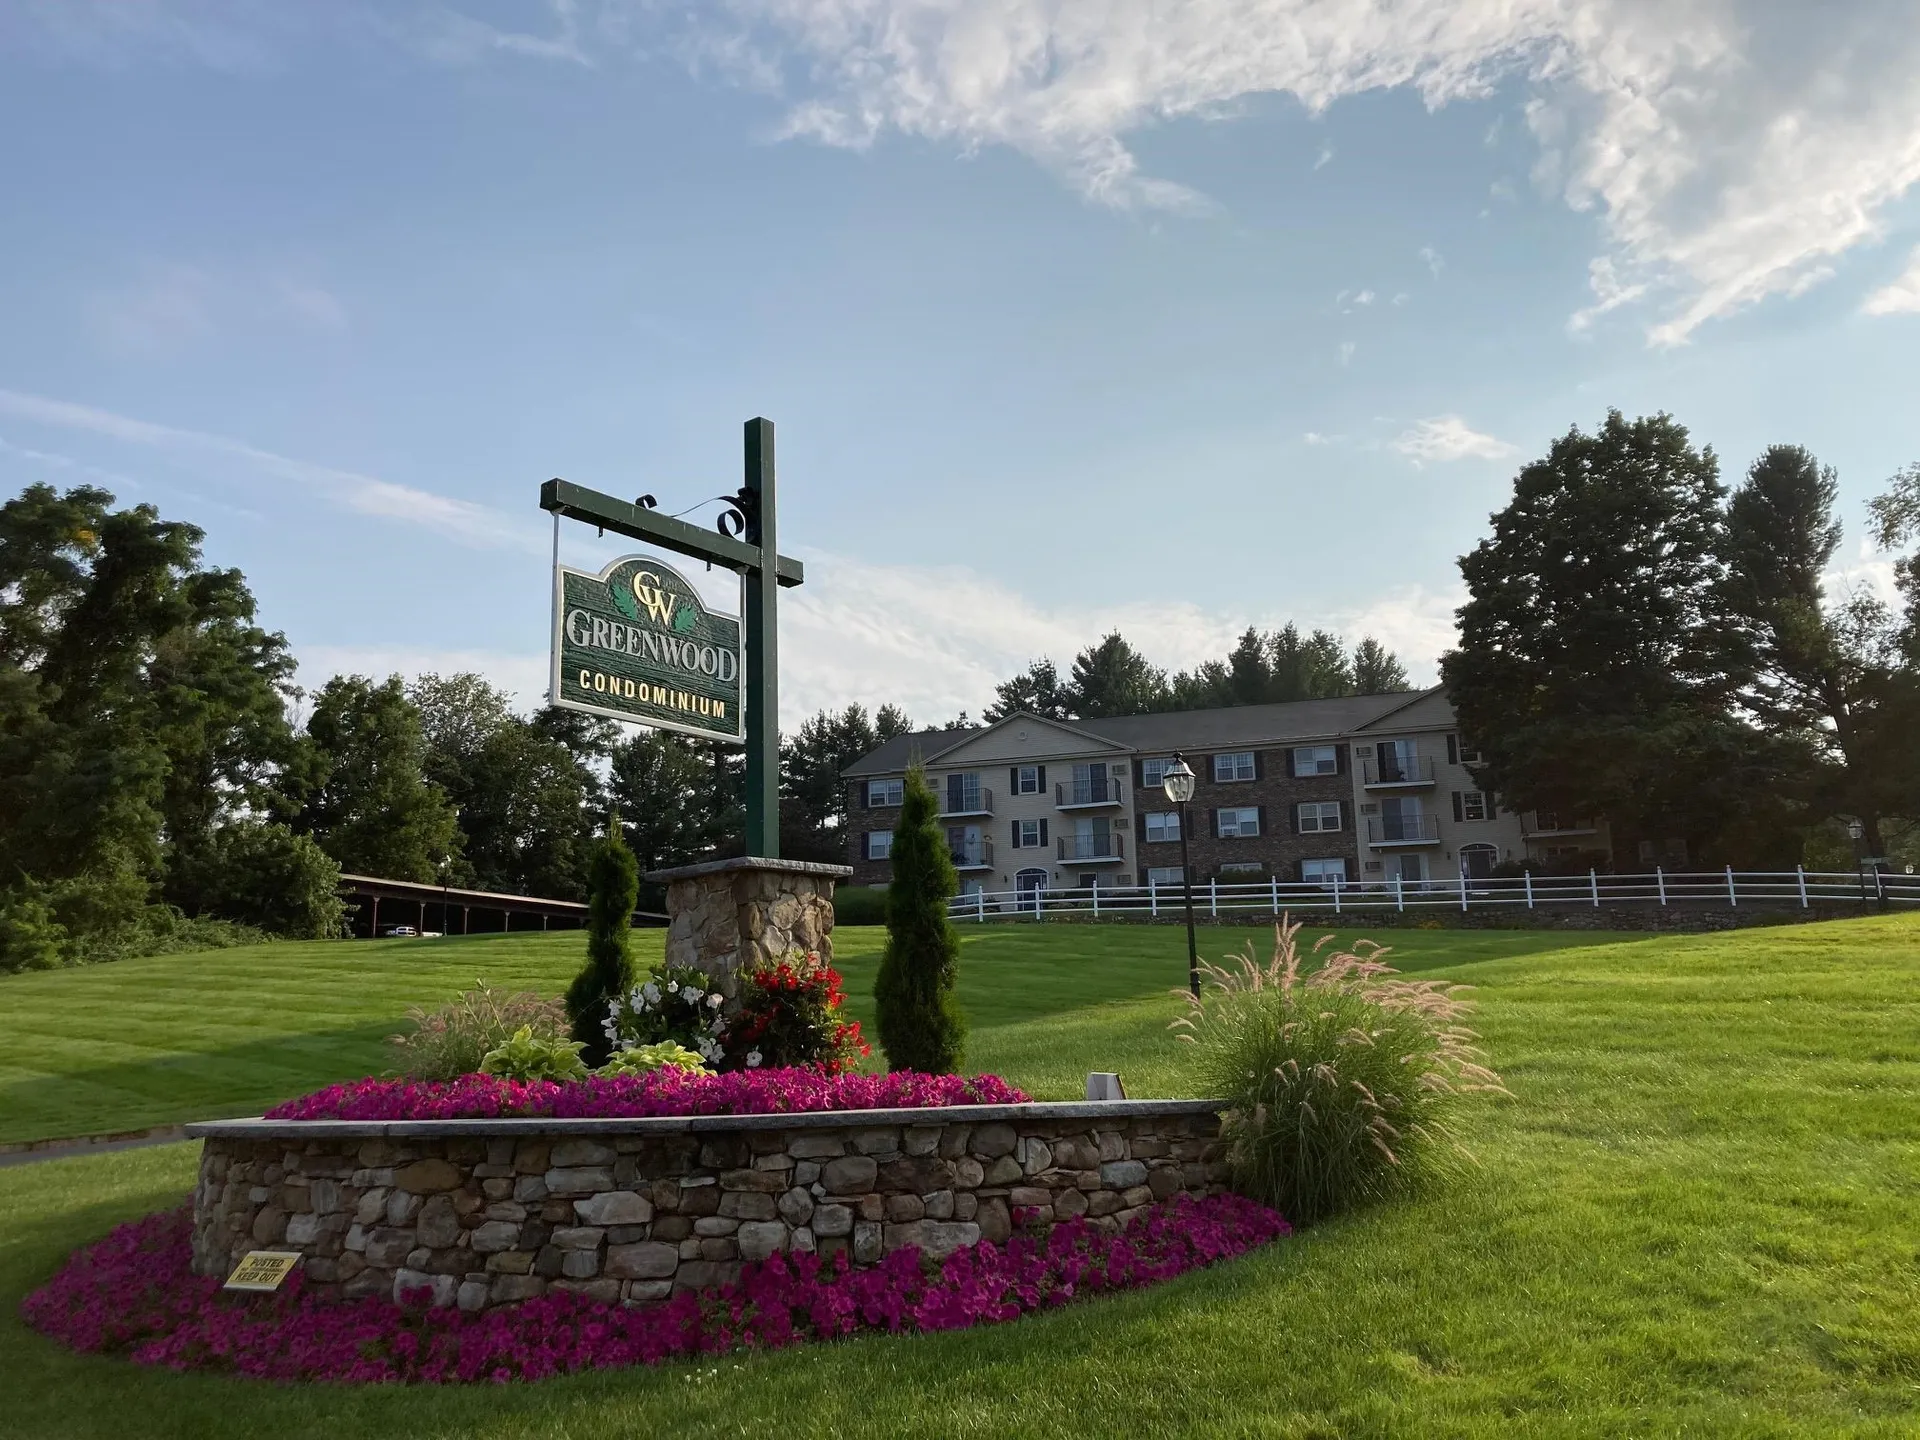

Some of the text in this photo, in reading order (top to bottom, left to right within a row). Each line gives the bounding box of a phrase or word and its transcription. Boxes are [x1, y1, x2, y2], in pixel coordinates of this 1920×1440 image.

[566, 609, 737, 682] GREENWOOD
[579, 669, 725, 719] CONDOMINIUM
[235, 1272, 279, 1282] KEEP OUT
[250, 1258, 285, 1267] POSTED
